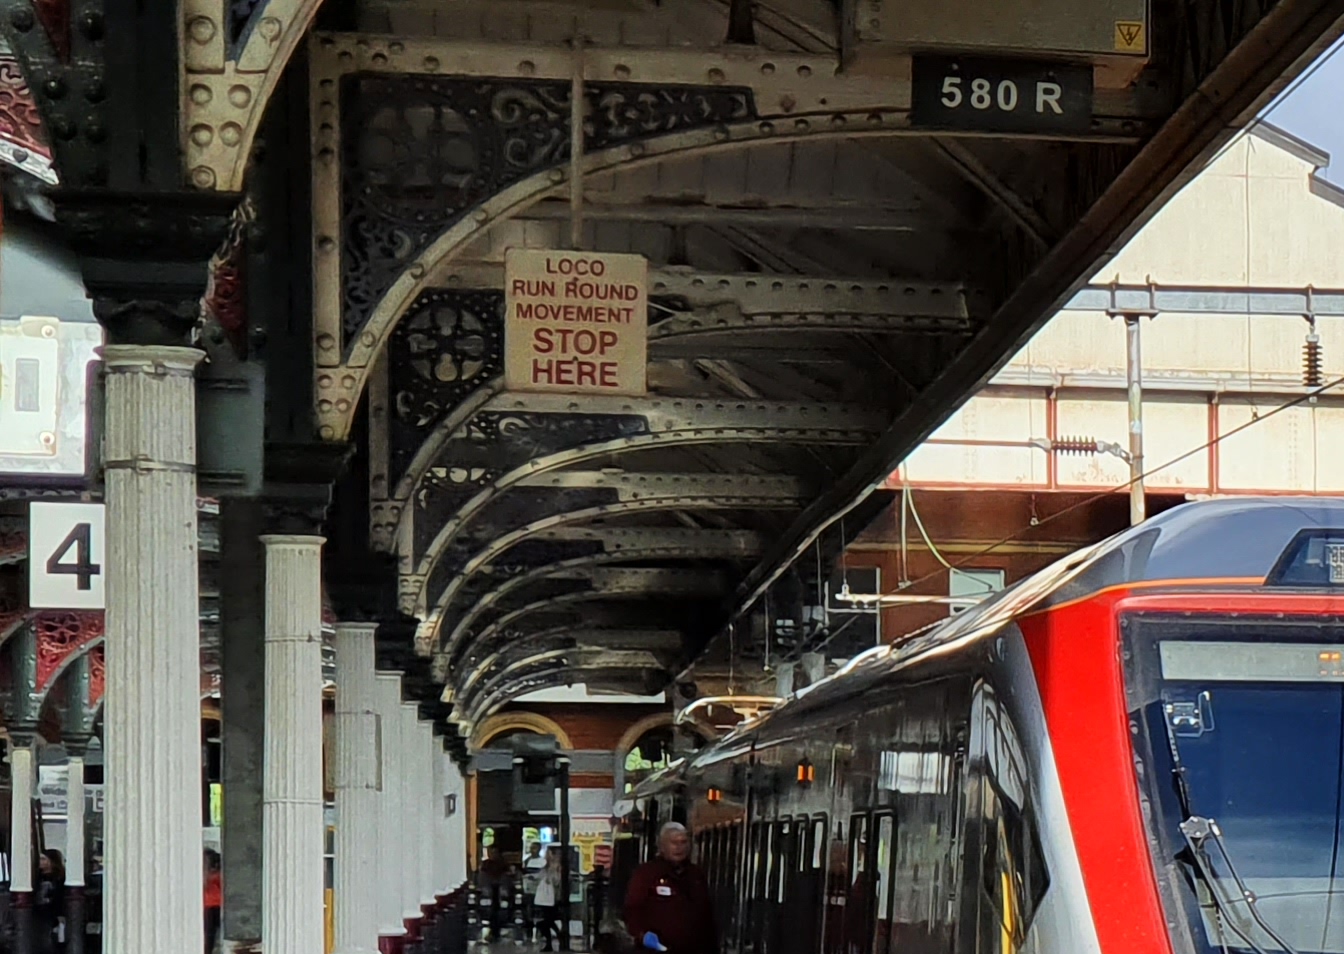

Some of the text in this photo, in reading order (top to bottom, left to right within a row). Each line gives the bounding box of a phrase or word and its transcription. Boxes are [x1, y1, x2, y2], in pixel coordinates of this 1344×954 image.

[941, 76, 1064, 114] 580 R
[545, 257, 605, 277] LOCO
[512, 279, 639, 301] RUN ROUND
[516, 302, 634, 323] MOVEMENT
[532, 327, 619, 355] STOP
[532, 358, 619, 387] HERE
[46, 522, 101, 591] 4
